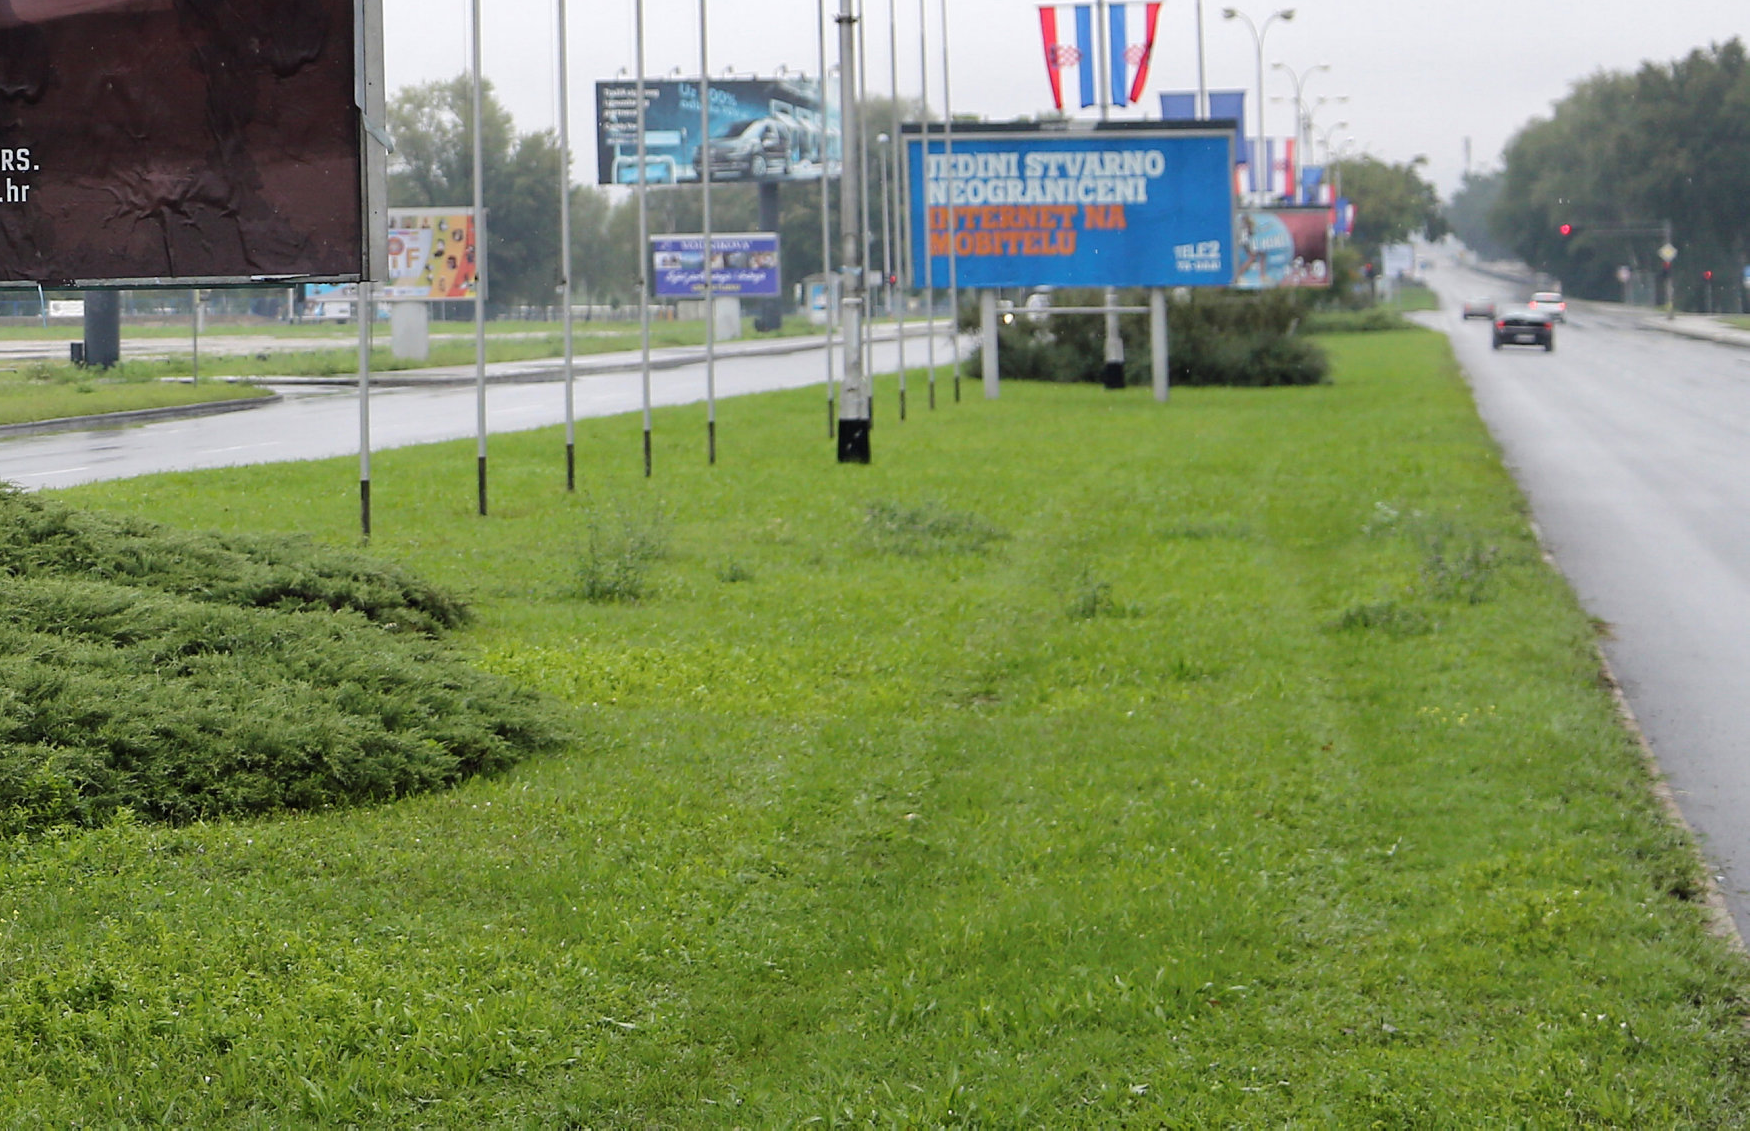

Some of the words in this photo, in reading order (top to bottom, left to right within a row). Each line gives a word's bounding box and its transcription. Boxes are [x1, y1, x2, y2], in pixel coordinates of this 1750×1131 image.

[1024, 150, 1165, 177] STVARNO
[1084, 204, 1127, 229] NA
[930, 230, 1077, 256] MOBITELU
